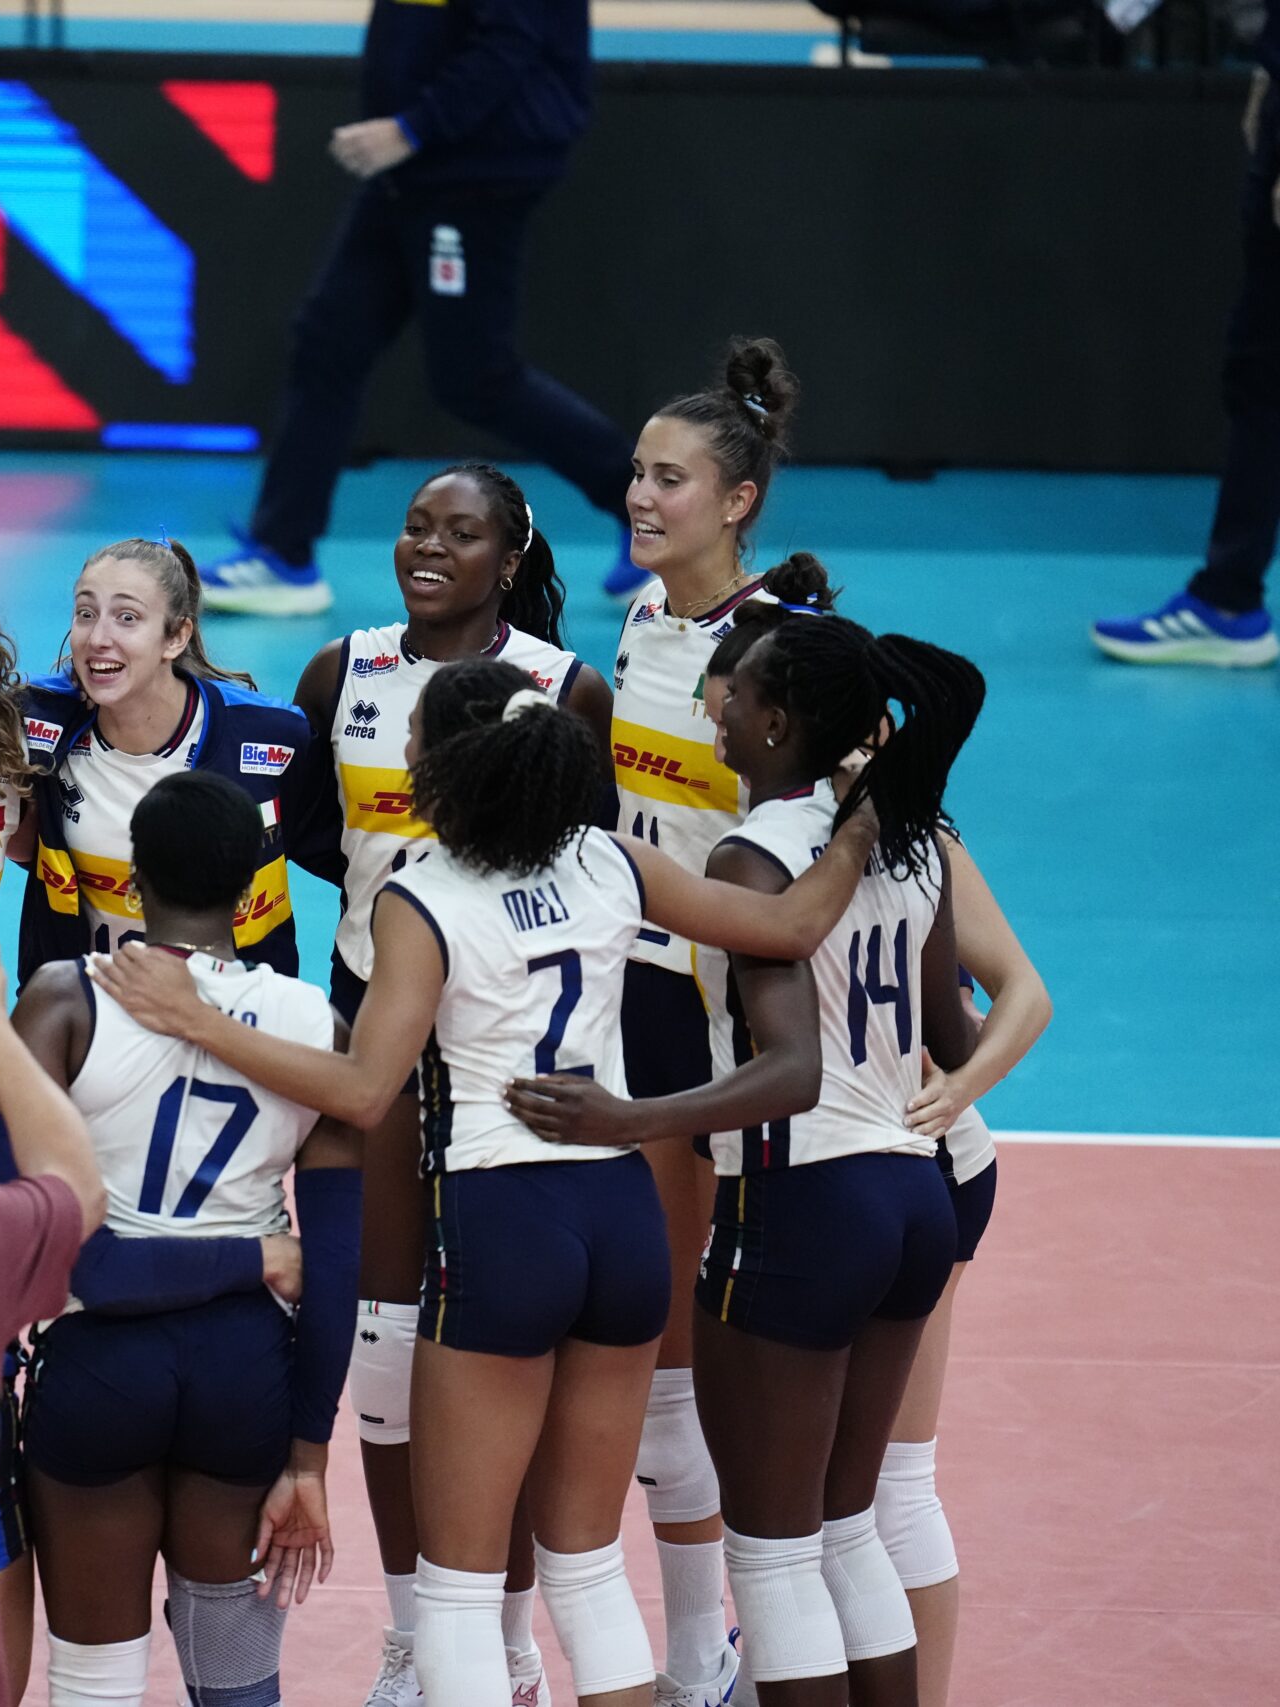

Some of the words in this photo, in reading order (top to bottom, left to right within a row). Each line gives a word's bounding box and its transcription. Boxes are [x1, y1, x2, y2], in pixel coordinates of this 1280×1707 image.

[344, 724, 376, 739] errea
[614, 742, 689, 785] DHL
[501, 880, 570, 933] MELI
[527, 948, 595, 1080] 2
[847, 918, 912, 1067] 14
[138, 1075, 260, 1218] 17
